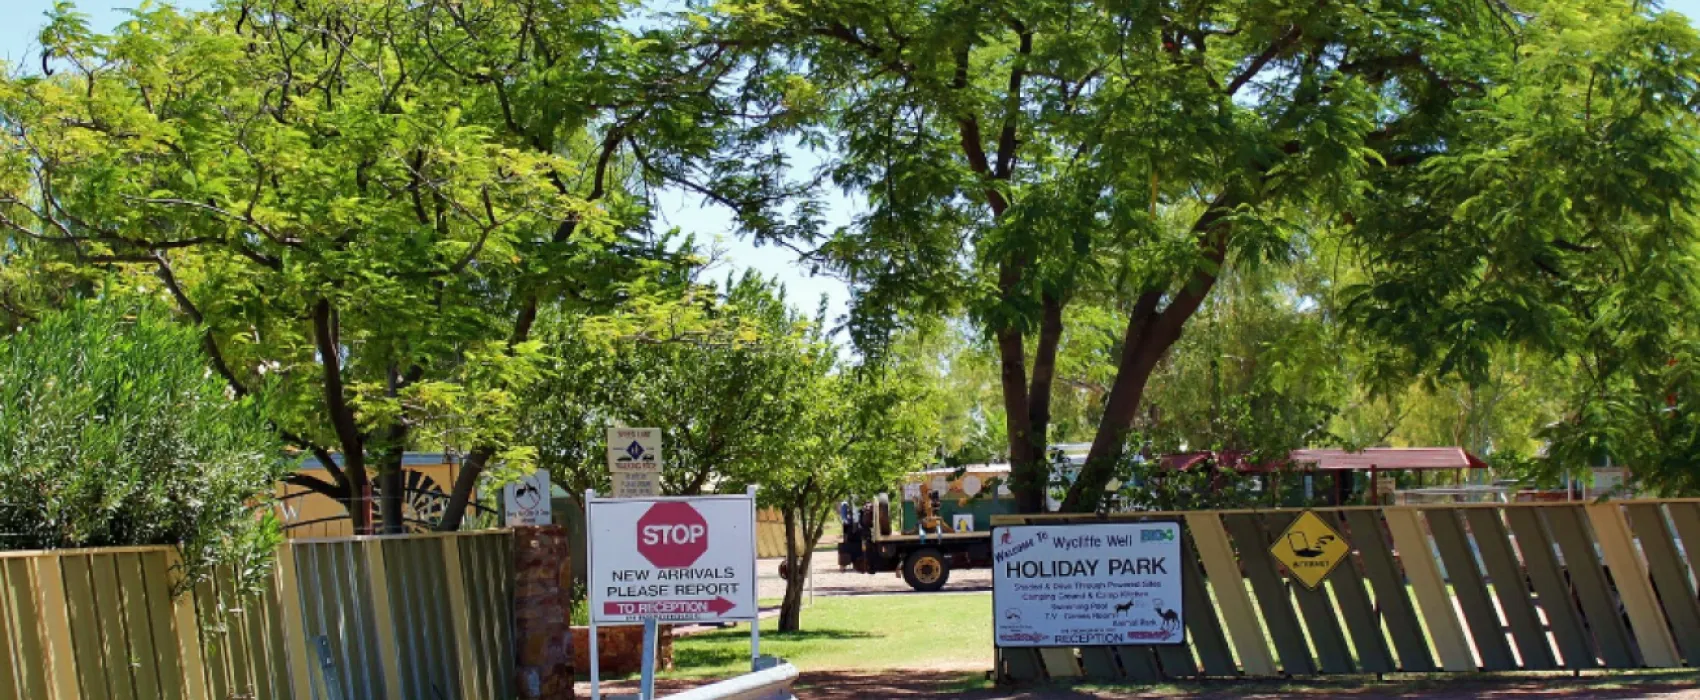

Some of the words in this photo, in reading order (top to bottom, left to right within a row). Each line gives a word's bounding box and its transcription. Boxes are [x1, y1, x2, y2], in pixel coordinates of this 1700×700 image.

[642, 524, 704, 545] STOP
[1053, 537, 1101, 550] Wycliffe
[1106, 535, 1132, 547] Well
[612, 569, 650, 582] NEW
[657, 567, 735, 580] ARRIVALS
[1006, 559, 1099, 578] HOLIDAY
[1108, 557, 1168, 575] PARK
[606, 585, 669, 597] PLEASE
[675, 582, 739, 595] REPORT
[1075, 582, 1106, 591] Through
[617, 603, 635, 614] TO
[639, 601, 708, 613] RECEPTION
[1054, 633, 1123, 643] RECEPTION
